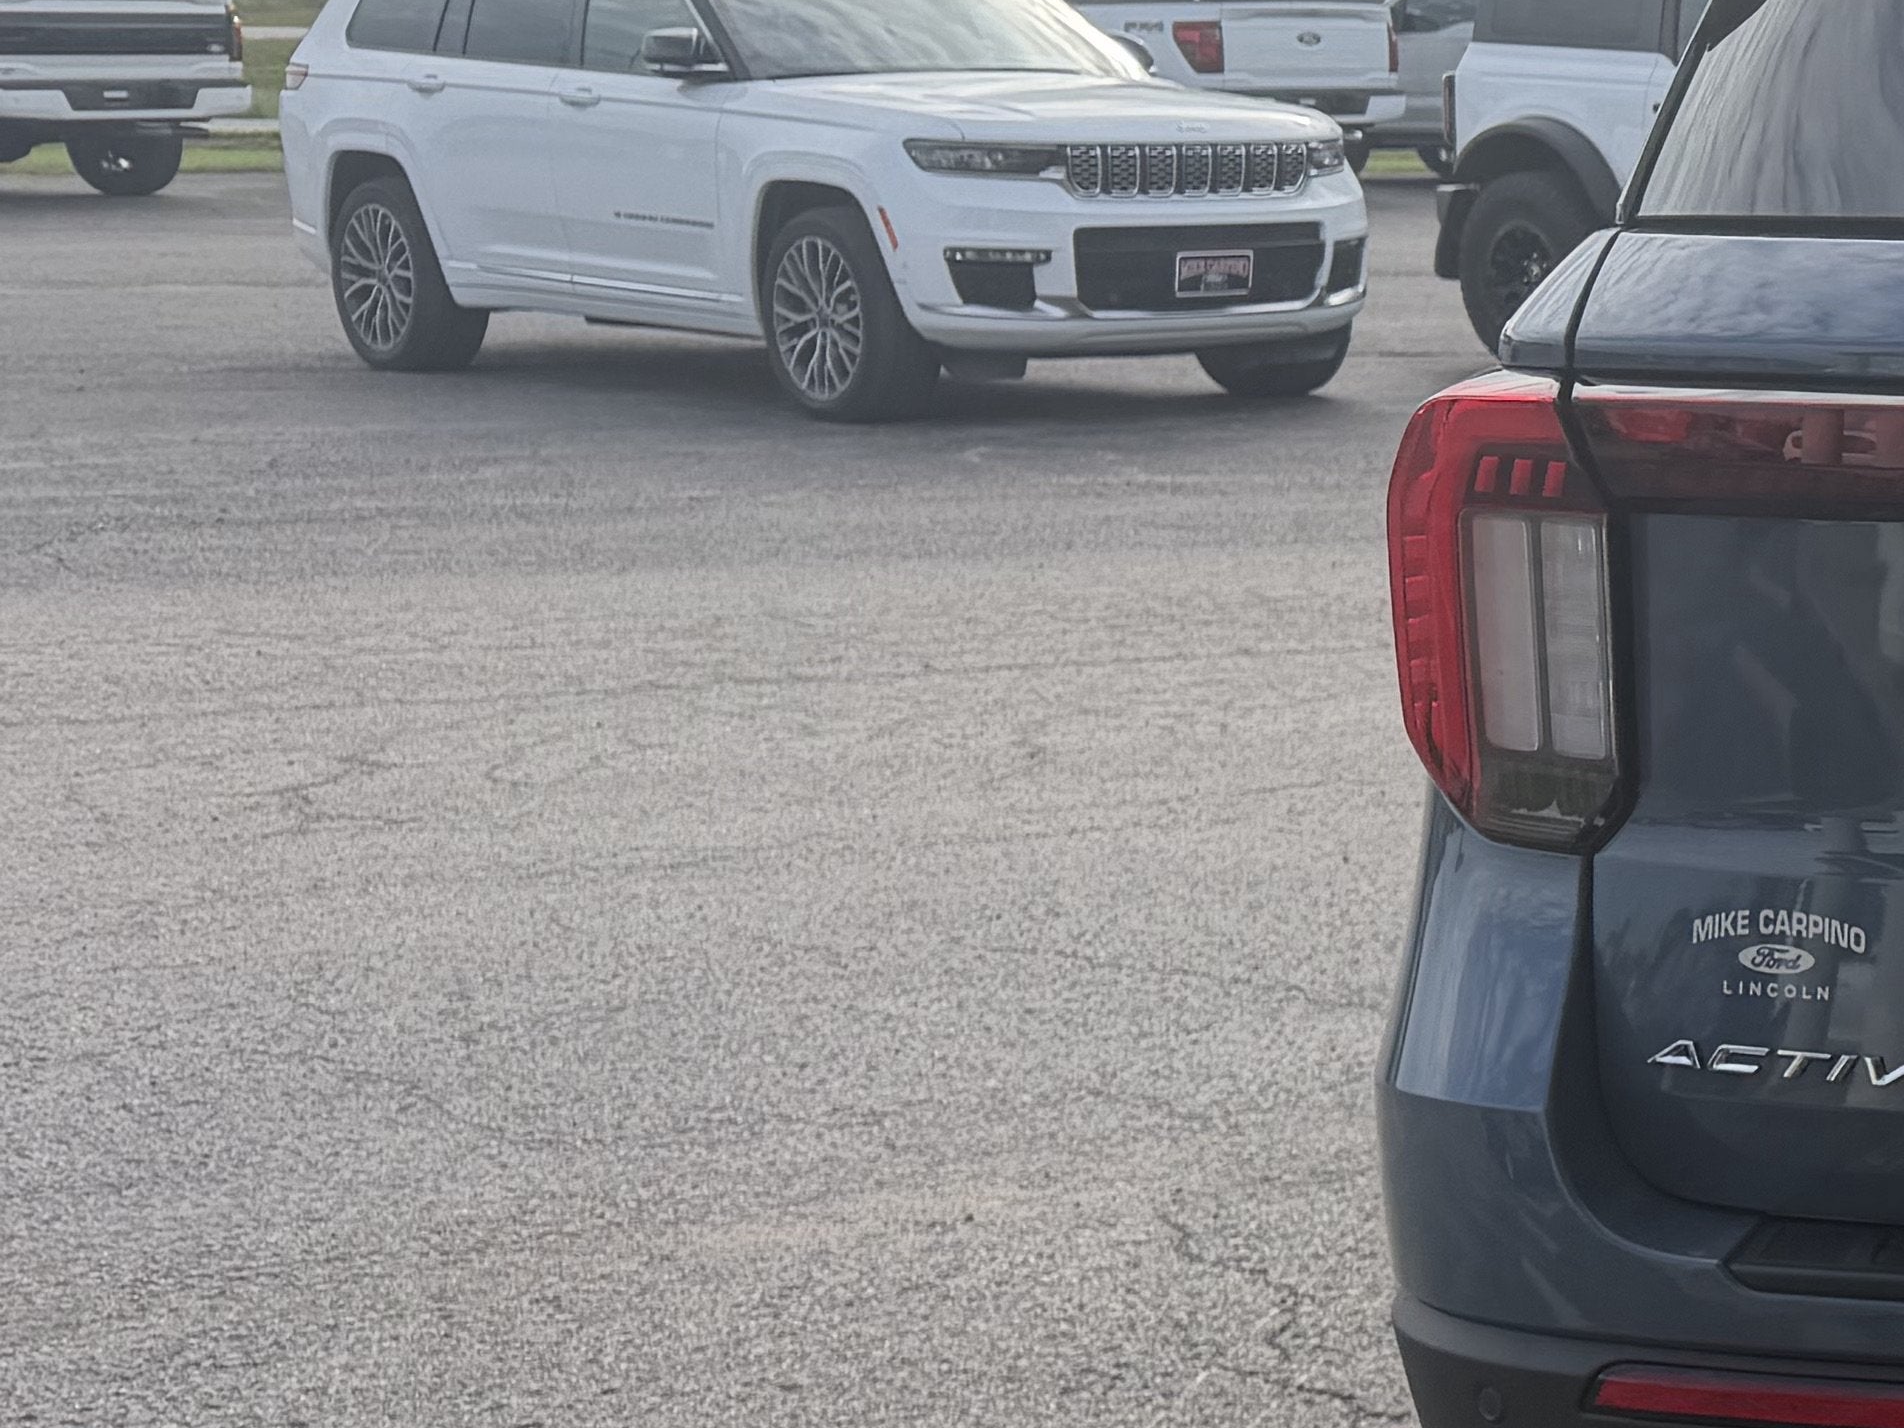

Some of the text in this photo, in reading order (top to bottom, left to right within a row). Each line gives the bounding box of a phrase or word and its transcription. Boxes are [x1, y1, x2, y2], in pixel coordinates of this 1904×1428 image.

[1692, 908, 1866, 954] MIKE CARPINO
[1751, 946, 1802, 970] Ford
[1722, 979, 1830, 1001] LINCOLN
